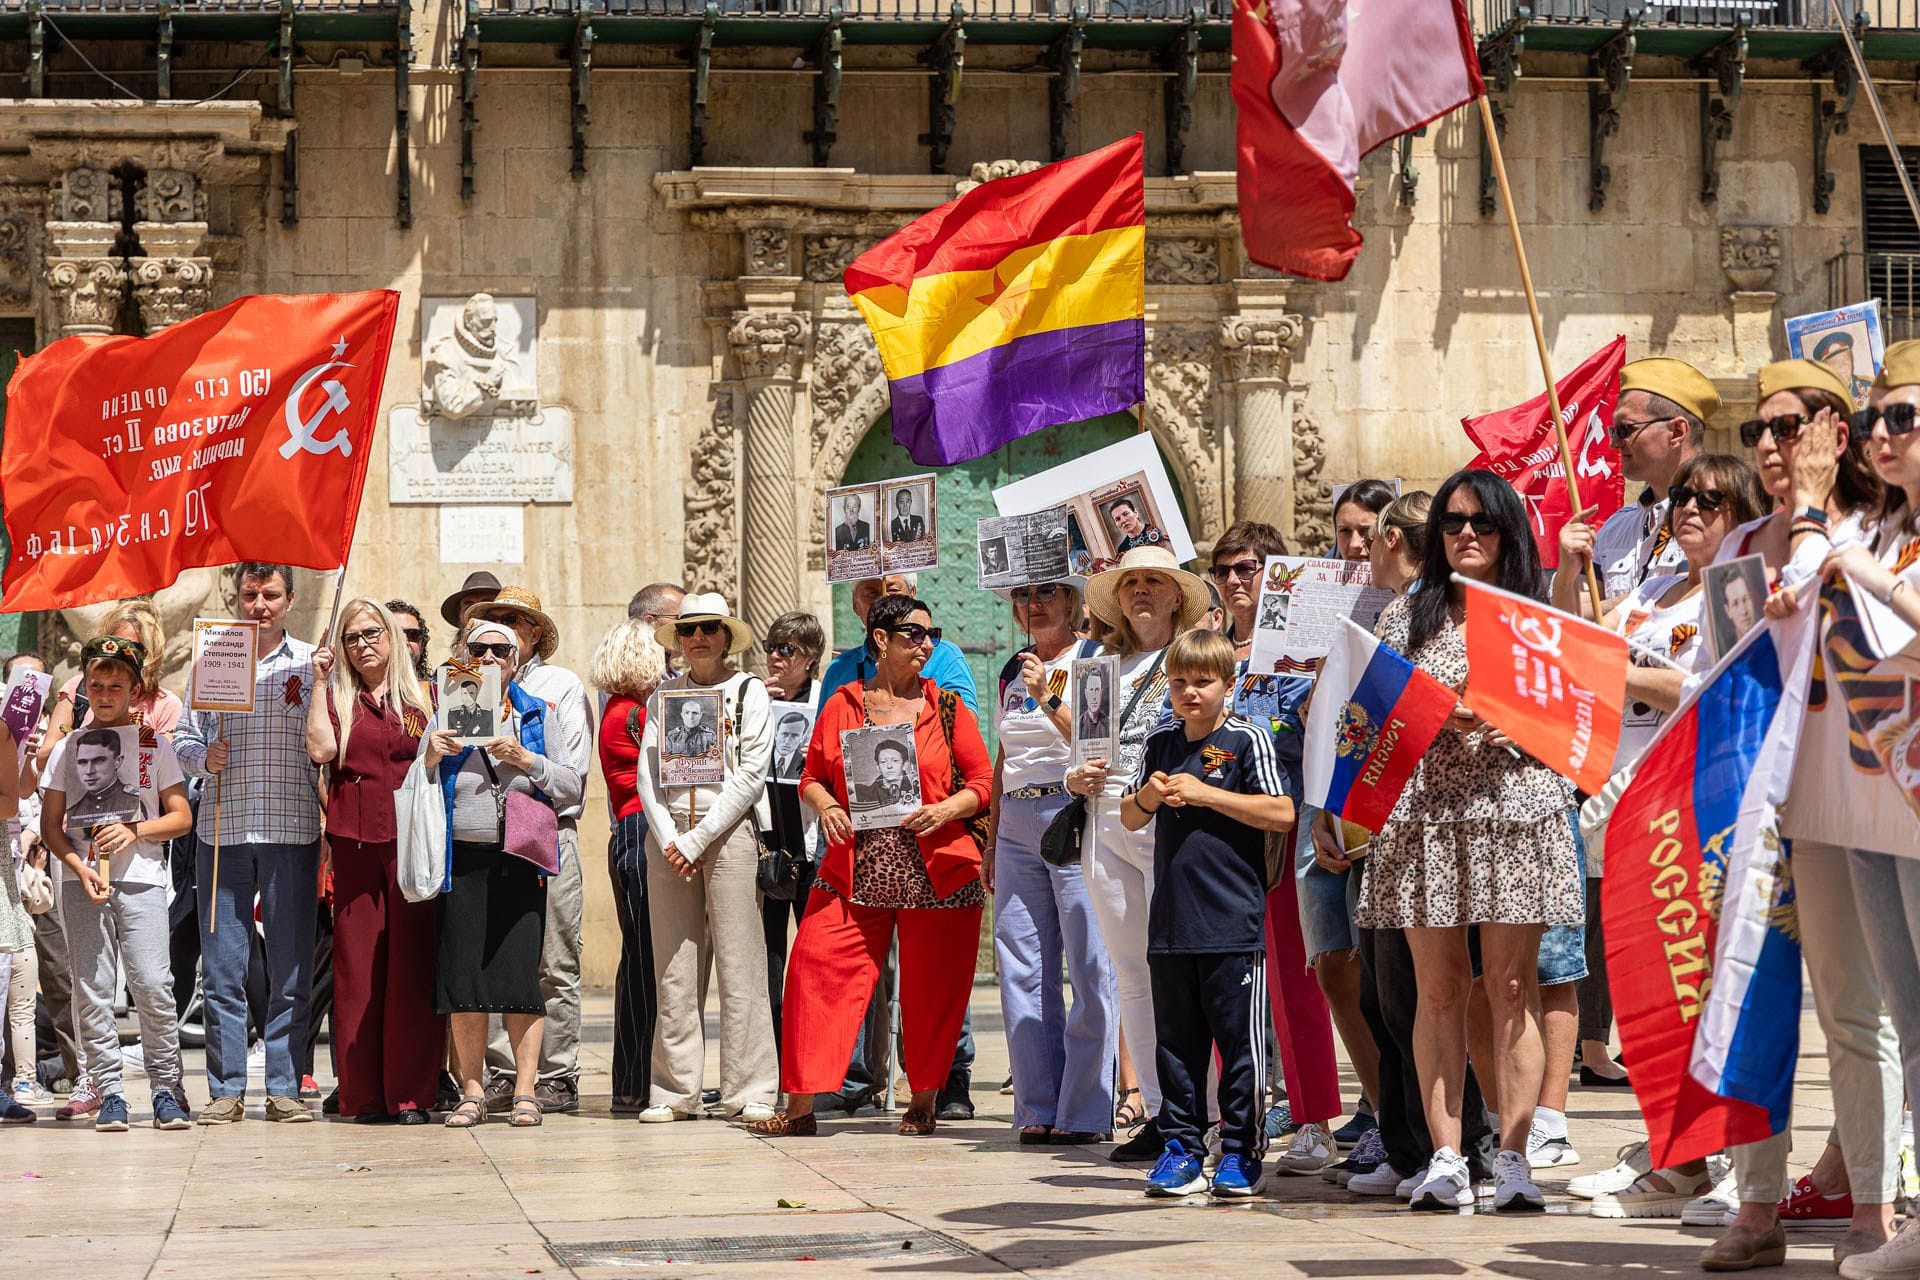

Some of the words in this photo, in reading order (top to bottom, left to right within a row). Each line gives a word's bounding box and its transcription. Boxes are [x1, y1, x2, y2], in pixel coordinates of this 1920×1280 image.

[1316, 573, 1327, 581] ЗА
[1335, 571, 1371, 586] ПОБЕД
[204, 629, 243, 637] Михайлов
[204, 640, 245, 648] Александр
[203, 650, 247, 658] Степанович
[678, 759, 707, 767] Фурин
[1649, 808, 1712, 1024] РОССИЯ
